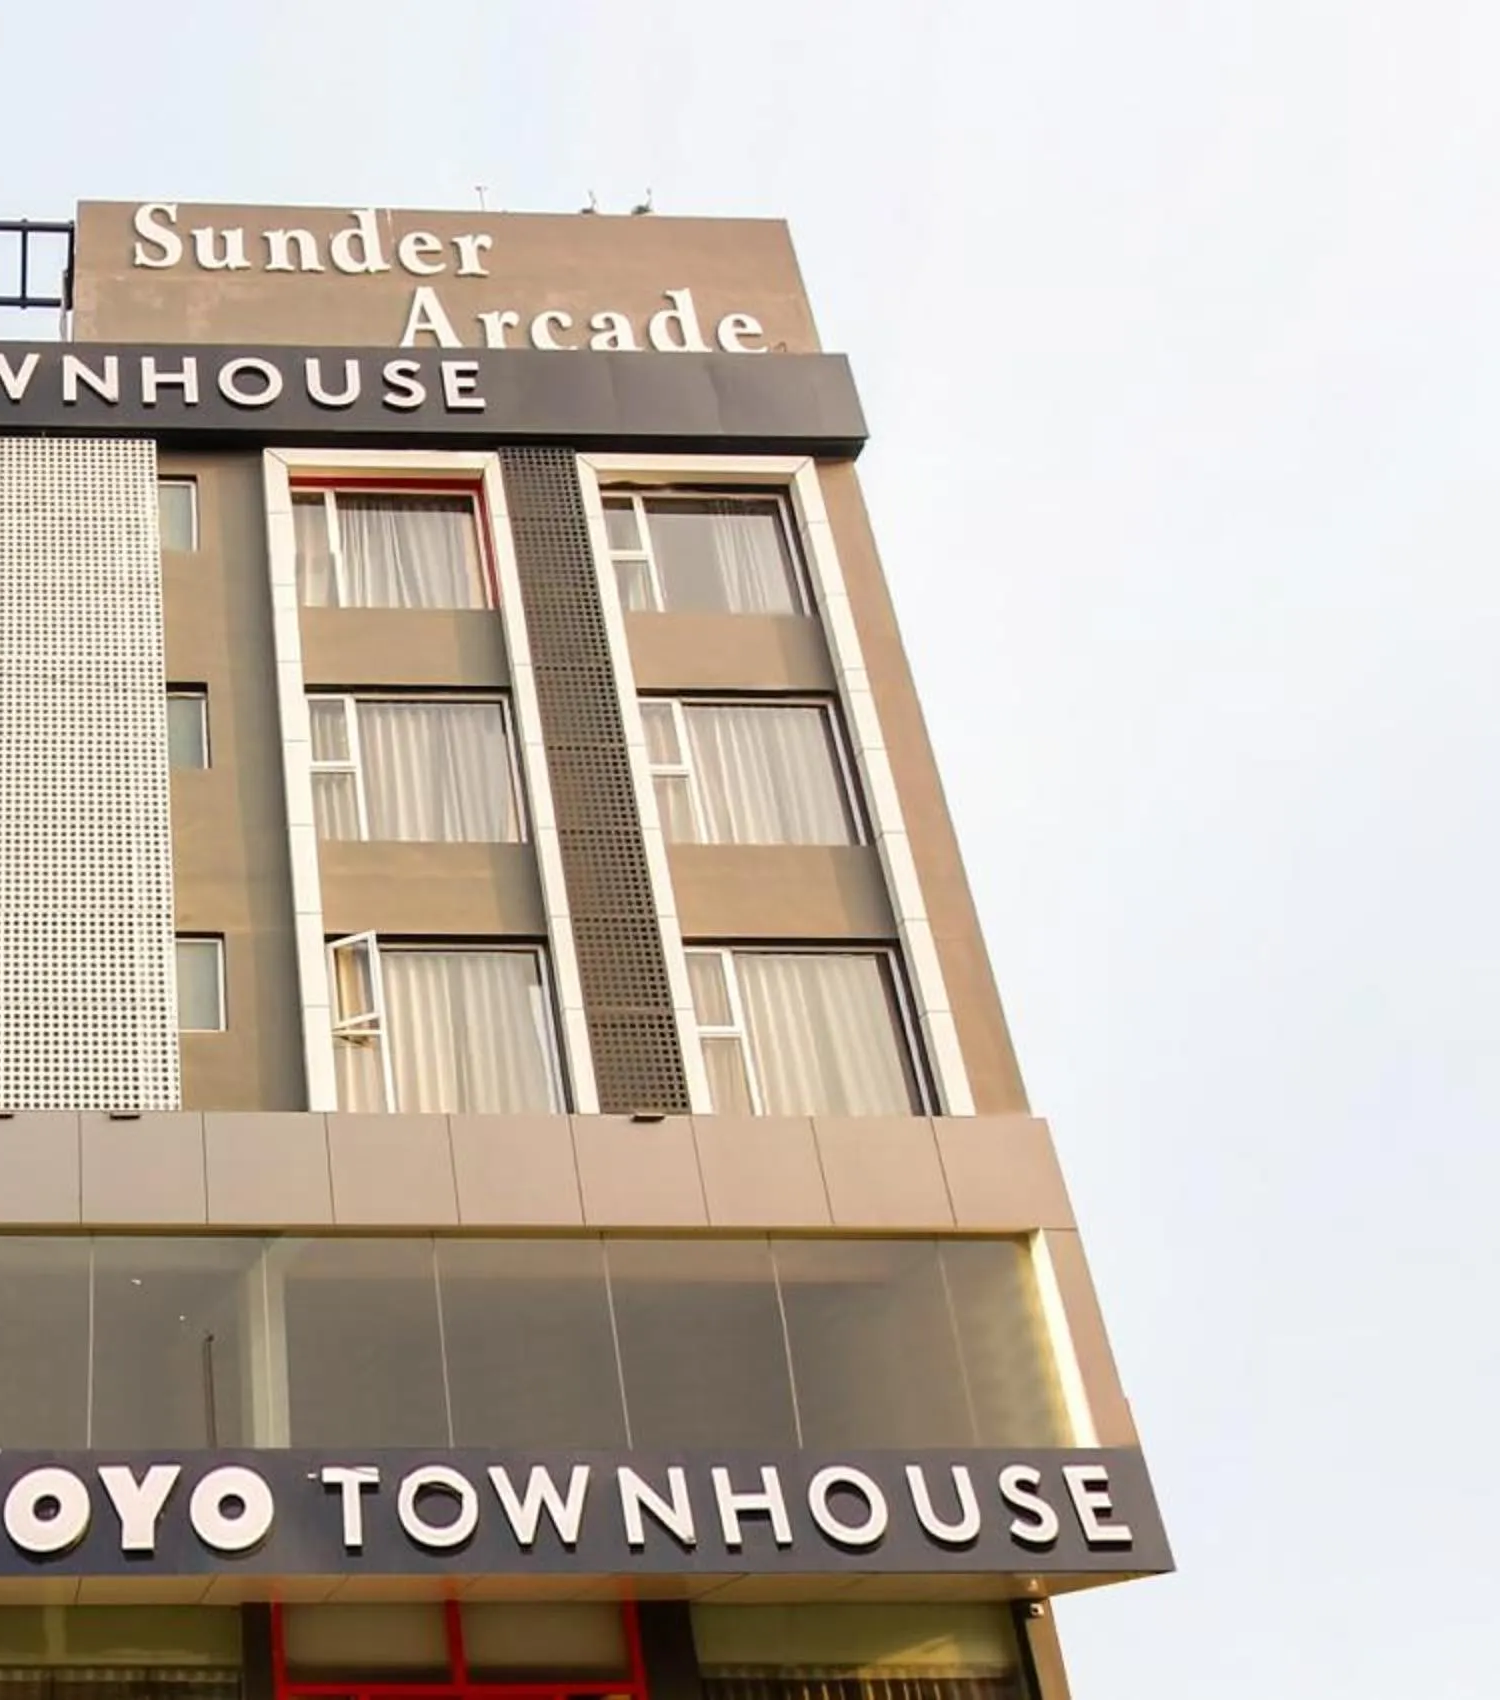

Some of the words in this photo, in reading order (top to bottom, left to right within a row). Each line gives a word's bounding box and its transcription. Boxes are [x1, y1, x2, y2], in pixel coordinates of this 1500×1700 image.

[133, 204, 493, 277] Sunder
[401, 287, 768, 353] Arcade
[4, 1465, 275, 1552] OYO
[321, 1464, 1134, 1549] TOWNHOUSE
